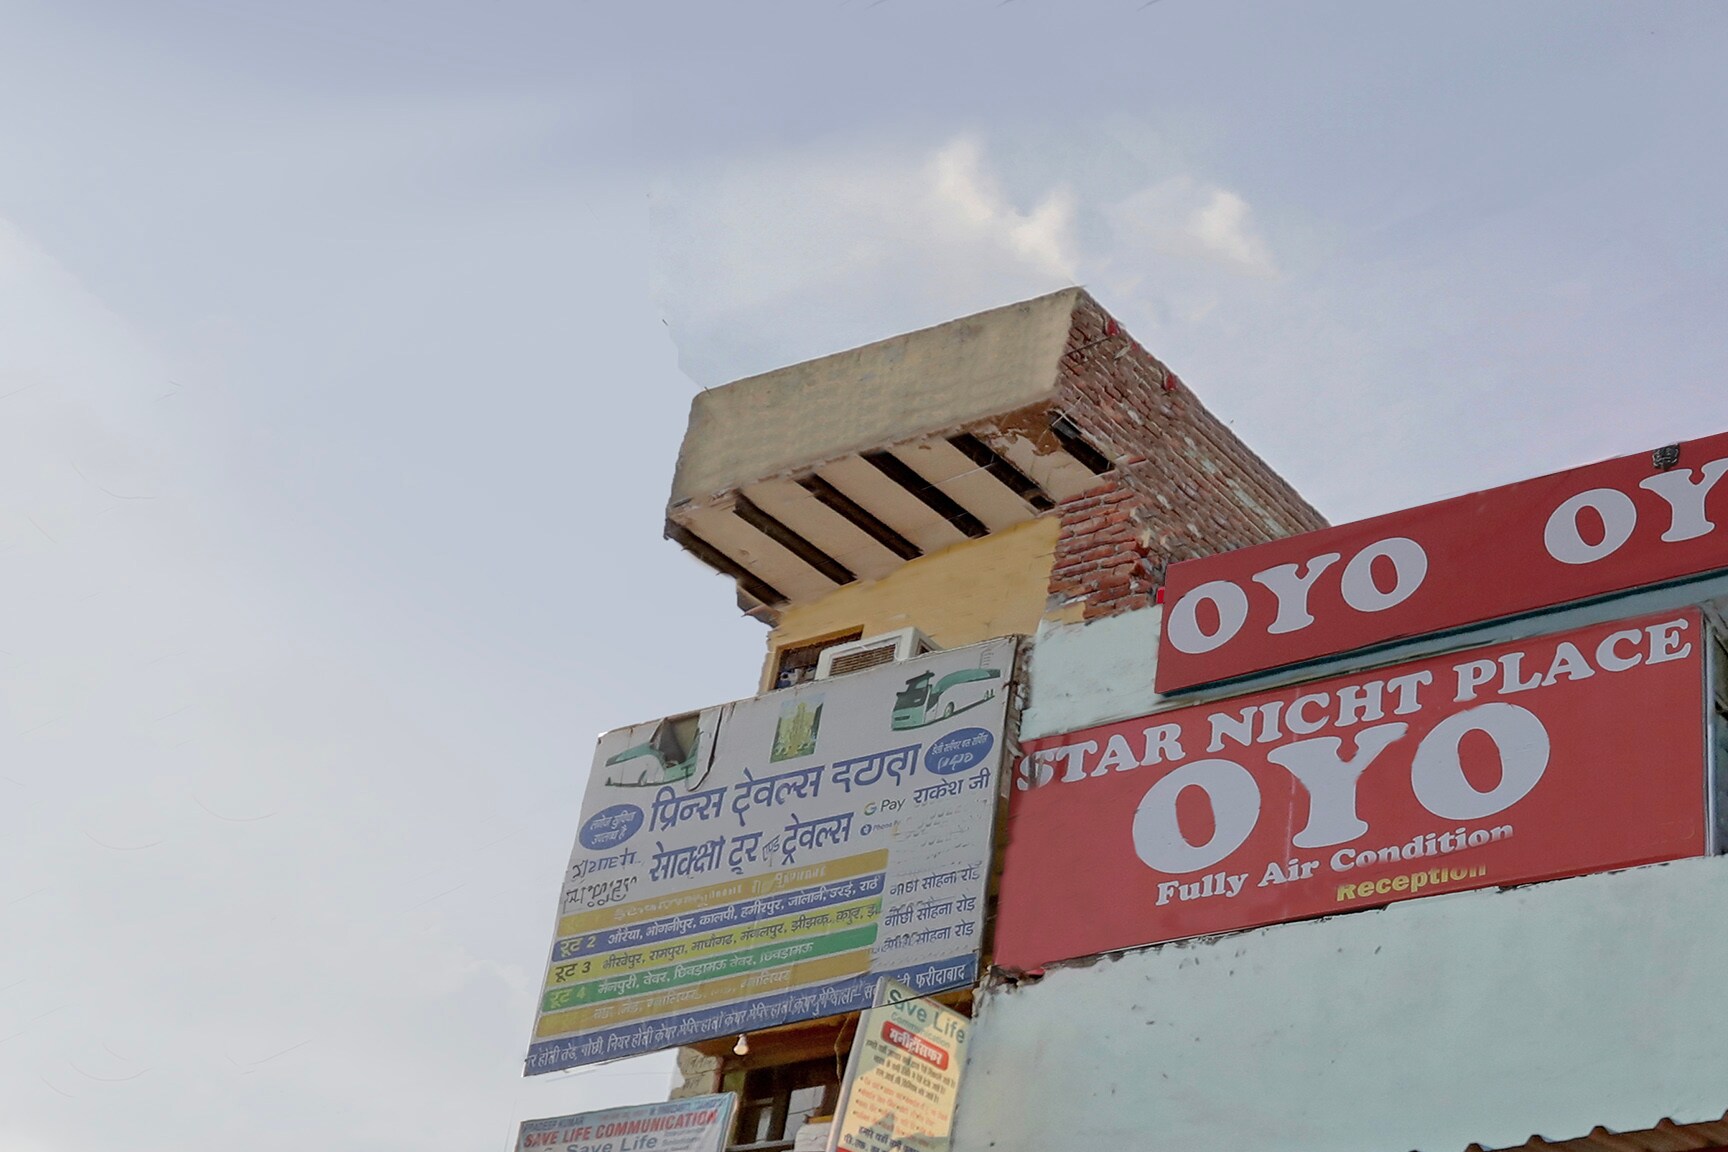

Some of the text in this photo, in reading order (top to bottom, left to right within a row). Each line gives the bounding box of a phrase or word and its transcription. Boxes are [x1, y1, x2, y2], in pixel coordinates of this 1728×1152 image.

[1167, 536, 1428, 654] OYO
[1016, 722, 1185, 792] STAR
[1454, 618, 1691, 702] PLACE
[913, 767, 991, 804] राकेश जी
[1132, 702, 1551, 873] OYO
[880, 798, 905, 813] Pay
[1155, 822, 1514, 907] Fully Air Condition
[1336, 865, 1487, 902] Reception
[587, 936, 597, 949] 2
[555, 963, 577, 983] रूट
[582, 962, 591, 974] 3
[916, 964, 966, 988] फरीदाबाद
[933, 1011, 965, 1044] Life
[524, 1130, 558, 1148] SAVE
[562, 1126, 591, 1143] LIFE
[595, 1109, 718, 1139] COMMUNICATION
[619, 1136, 658, 1152] Life
